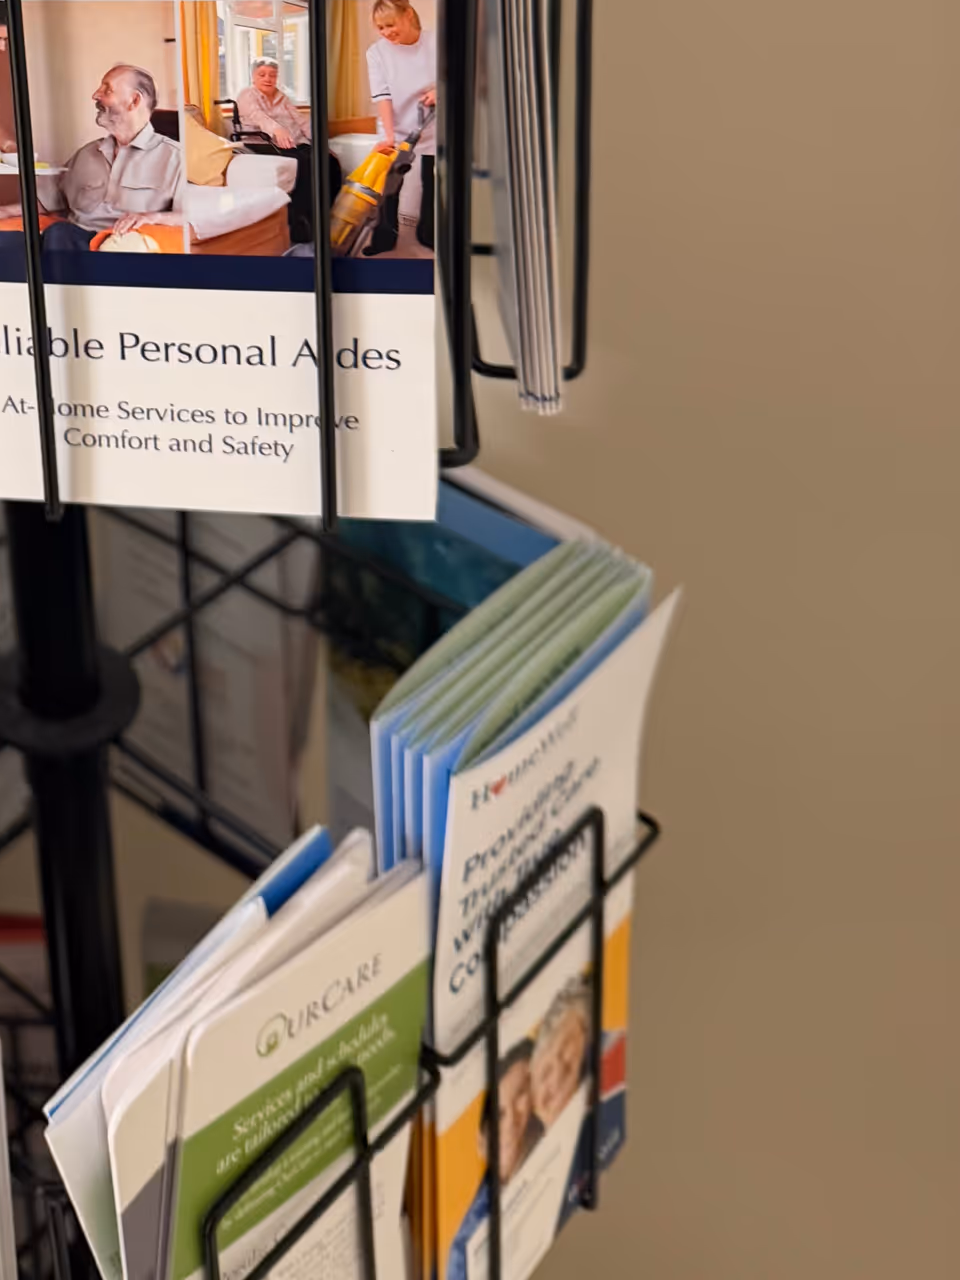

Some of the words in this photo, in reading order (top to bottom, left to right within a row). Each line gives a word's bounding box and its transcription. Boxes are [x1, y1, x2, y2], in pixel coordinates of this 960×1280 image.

[119, 331, 278, 368] Personal
[291, 337, 402, 371] Ades
[1, 395, 110, 419] At-ome
[117, 400, 216, 424] Services
[224, 408, 248, 426] to
[63, 427, 161, 452] Comfort
[168, 432, 214, 454] and
[222, 435, 295, 464] Safety
[448, 826, 587, 995] Copassion
[232, 1088, 293, 1141] Services
